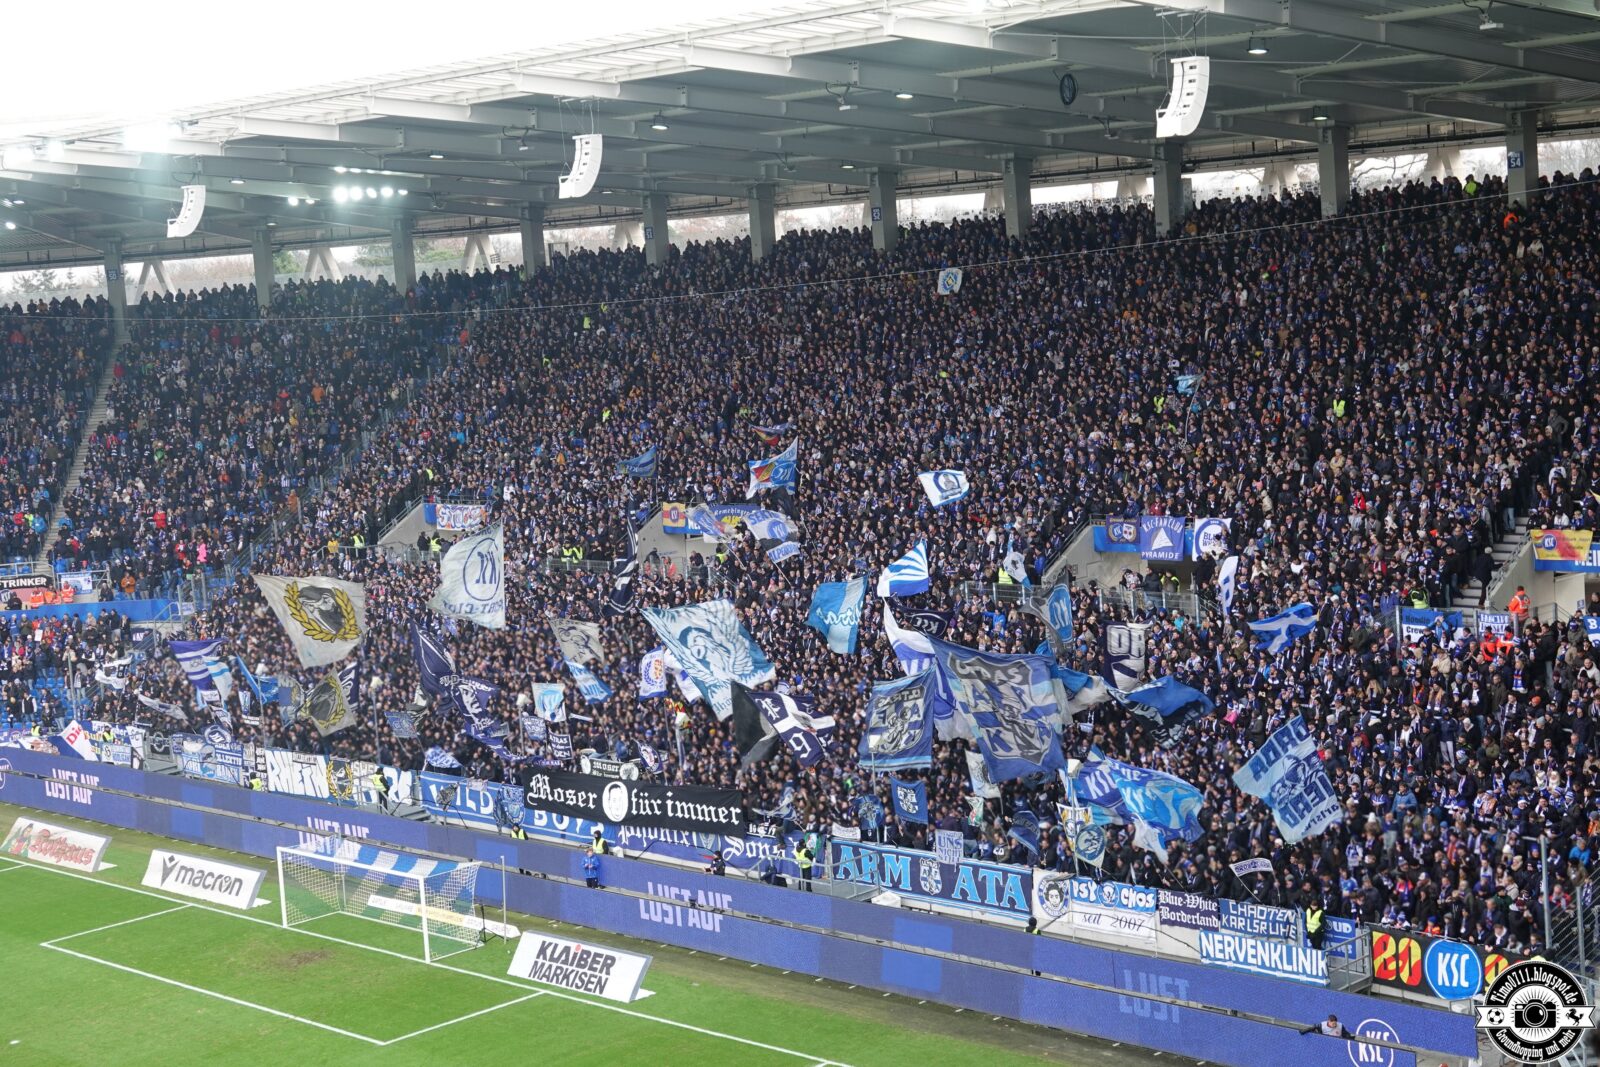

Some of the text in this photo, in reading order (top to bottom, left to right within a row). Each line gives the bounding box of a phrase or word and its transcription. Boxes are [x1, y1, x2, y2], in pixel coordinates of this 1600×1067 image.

[1141, 551, 1180, 560] PYRAMIDE
[0, 577, 47, 589] TRINKER
[527, 773, 741, 825] Moser für immer
[175, 865, 243, 897] macron
[952, 865, 1029, 912] ATA
[1072, 880, 1097, 902] PSY
[1120, 887, 1155, 909] CHOS
[640, 882, 733, 933] LUST AUF
[1158, 890, 1218, 912] Blue-White
[1229, 901, 1297, 922] CHAOTEN
[1110, 916, 1145, 932] 2007
[1159, 906, 1219, 928] Borderland
[1222, 914, 1297, 940] KARLSRUHE
[1200, 932, 1329, 978] NERVENKLINIK
[1437, 952, 1470, 987] KSC
[528, 960, 610, 995] MARKISEN
[1119, 968, 1191, 1025] LUST
